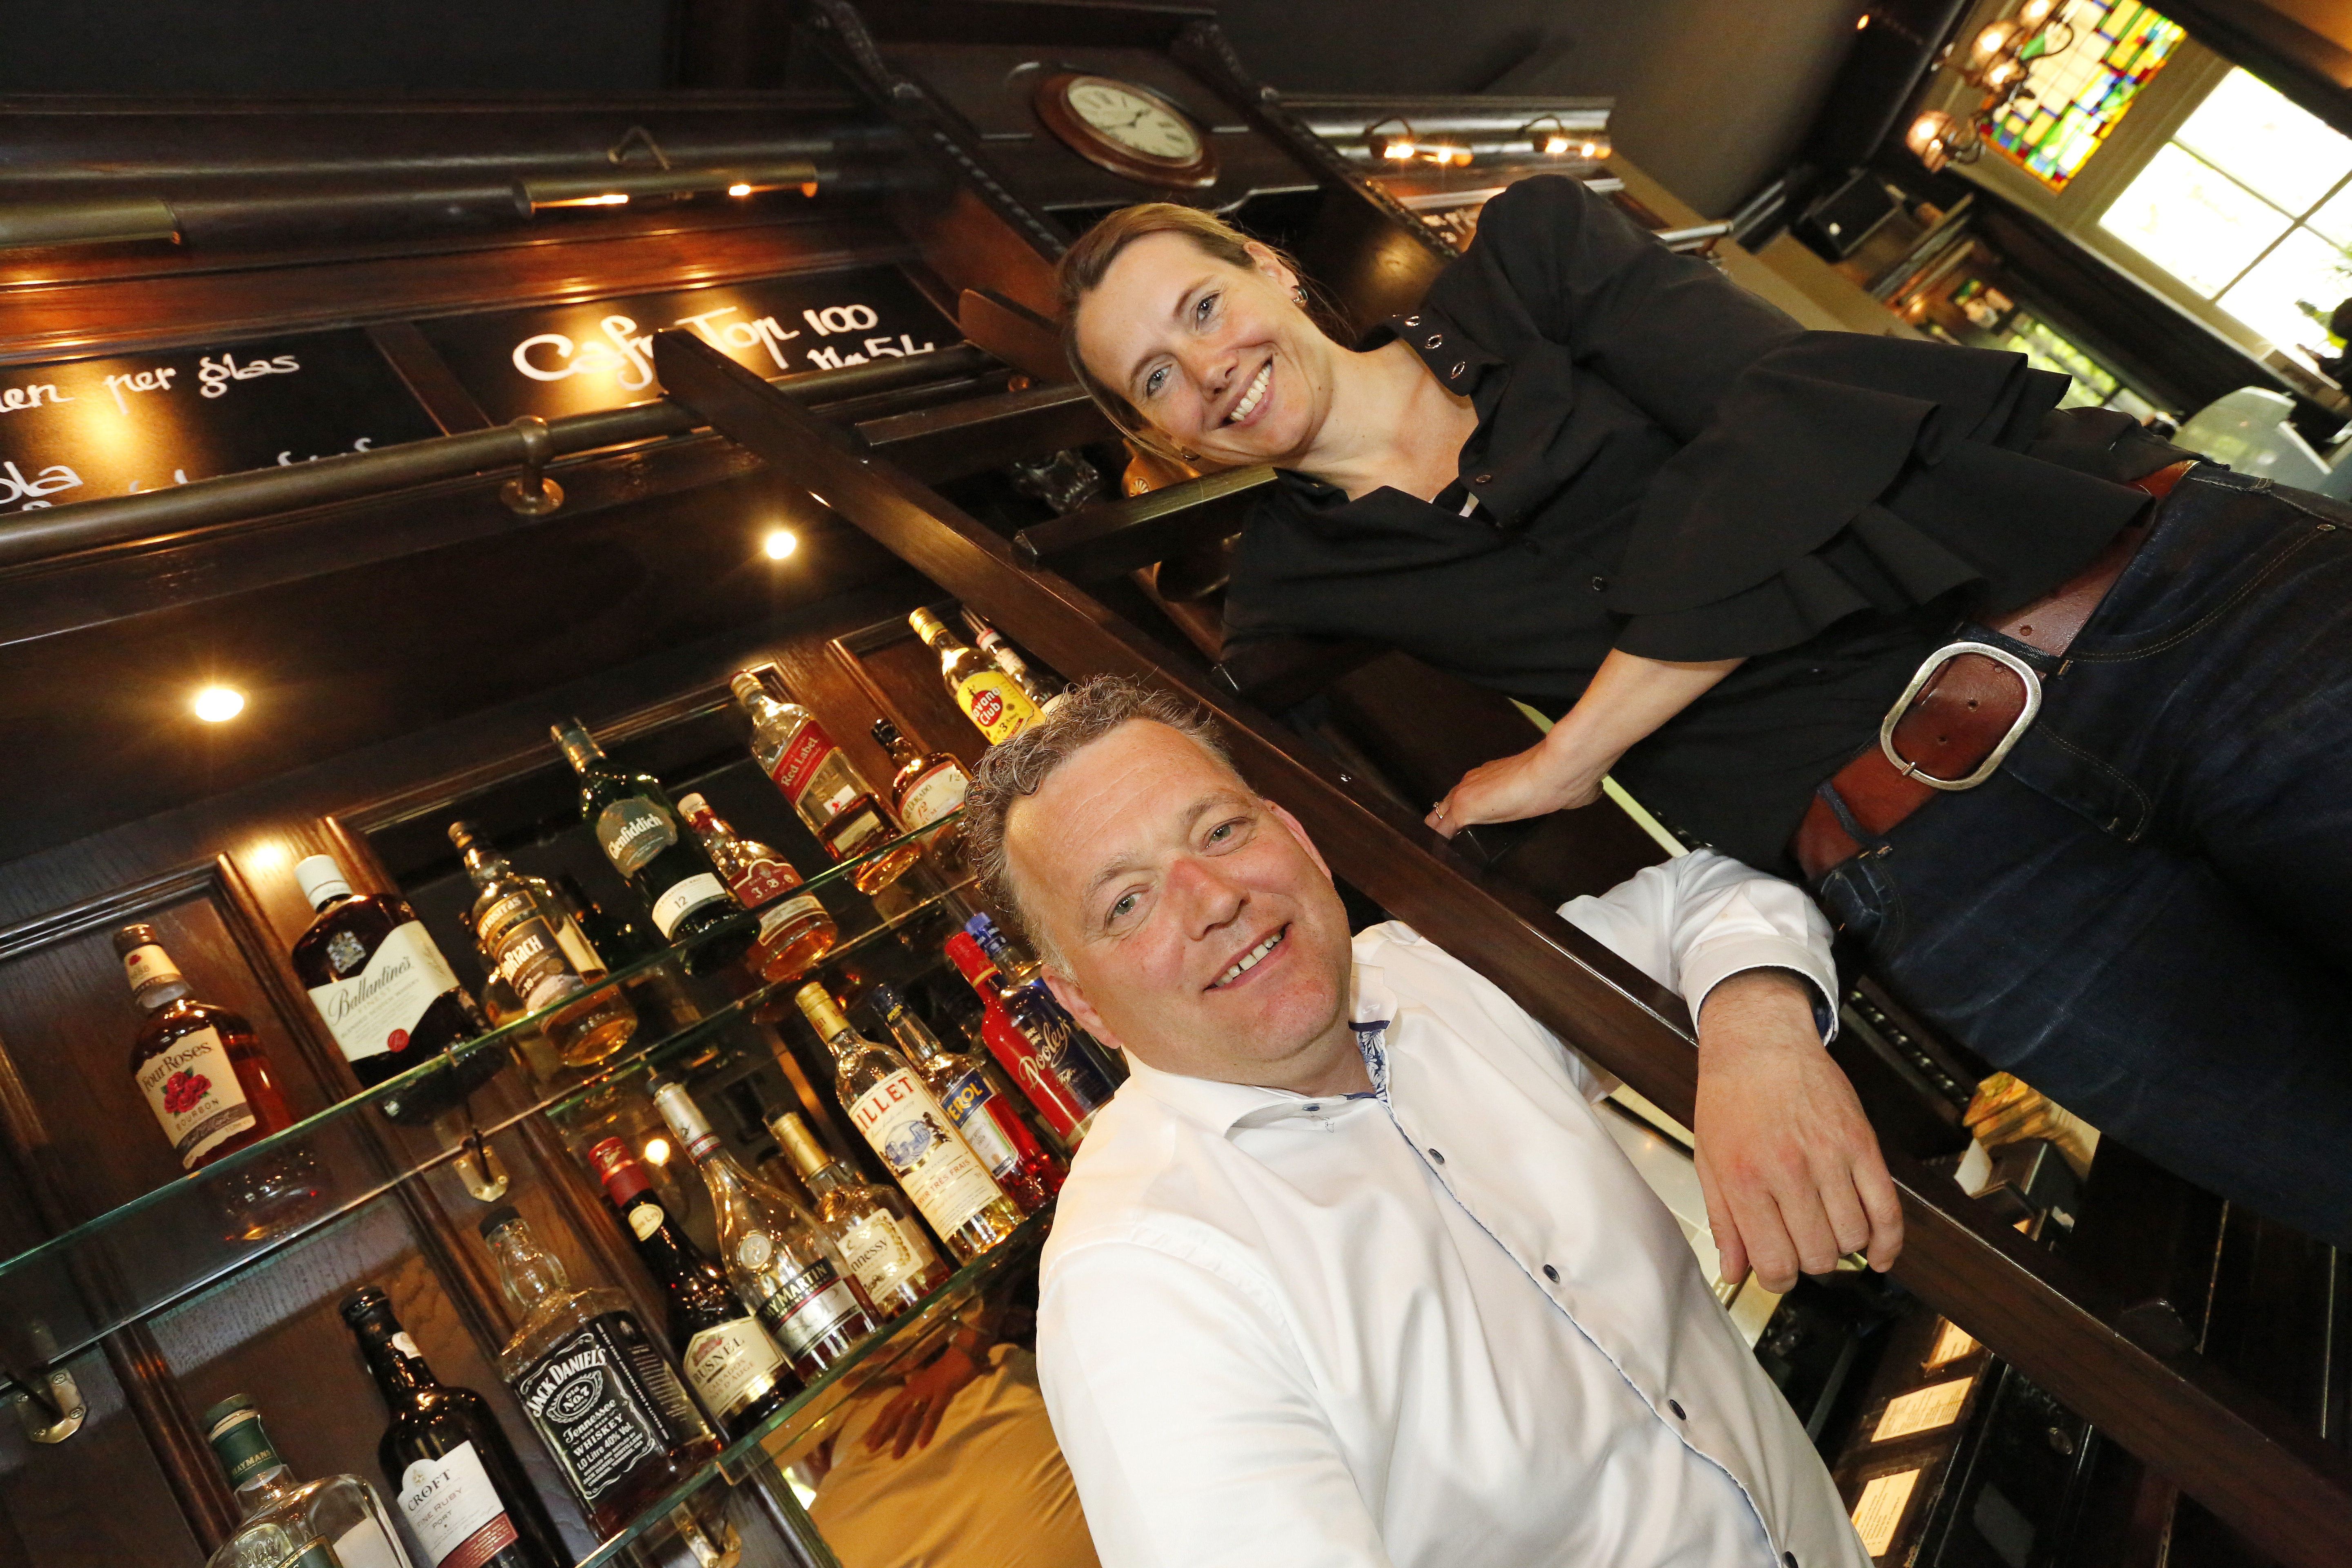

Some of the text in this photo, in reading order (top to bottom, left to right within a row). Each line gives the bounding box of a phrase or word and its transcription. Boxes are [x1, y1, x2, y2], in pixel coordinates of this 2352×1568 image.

[674, 306, 800, 370] Top
[803, 304, 878, 336] 100
[0, 353, 299, 414] en per glas
[980, 702, 1001, 725] Club
[998, 722, 1008, 732] 3
[780, 736, 819, 787] Red Label
[608, 813, 663, 860] Glenfiddich
[673, 895, 688, 908] 12
[328, 956, 412, 1026] Ballantine's
[141, 1042, 213, 1092] Four Roses
[175, 1098, 219, 1131] BOURBON
[947, 1082, 983, 1121] EROL
[930, 1172, 949, 1191] TRÈS
[949, 1158, 971, 1176] FRAIS
[850, 1236, 887, 1271] nnessy
[774, 1263, 827, 1307] MARTIN
[526, 1344, 606, 1417] JACK DANIEL'S
[693, 1337, 744, 1383] BUSNEL
[562, 1385, 590, 1412] No.7
[562, 1399, 617, 1443] Tennessee
[573, 1412, 624, 1456] WHISKEY
[586, 1445, 605, 1463] Litre
[604, 1431, 621, 1447] 40%
[618, 1421, 633, 1435] Vol.
[406, 1468, 450, 1511] CROFT
[417, 1487, 461, 1526] FINE RUBY
[432, 1510, 451, 1528] PORT
